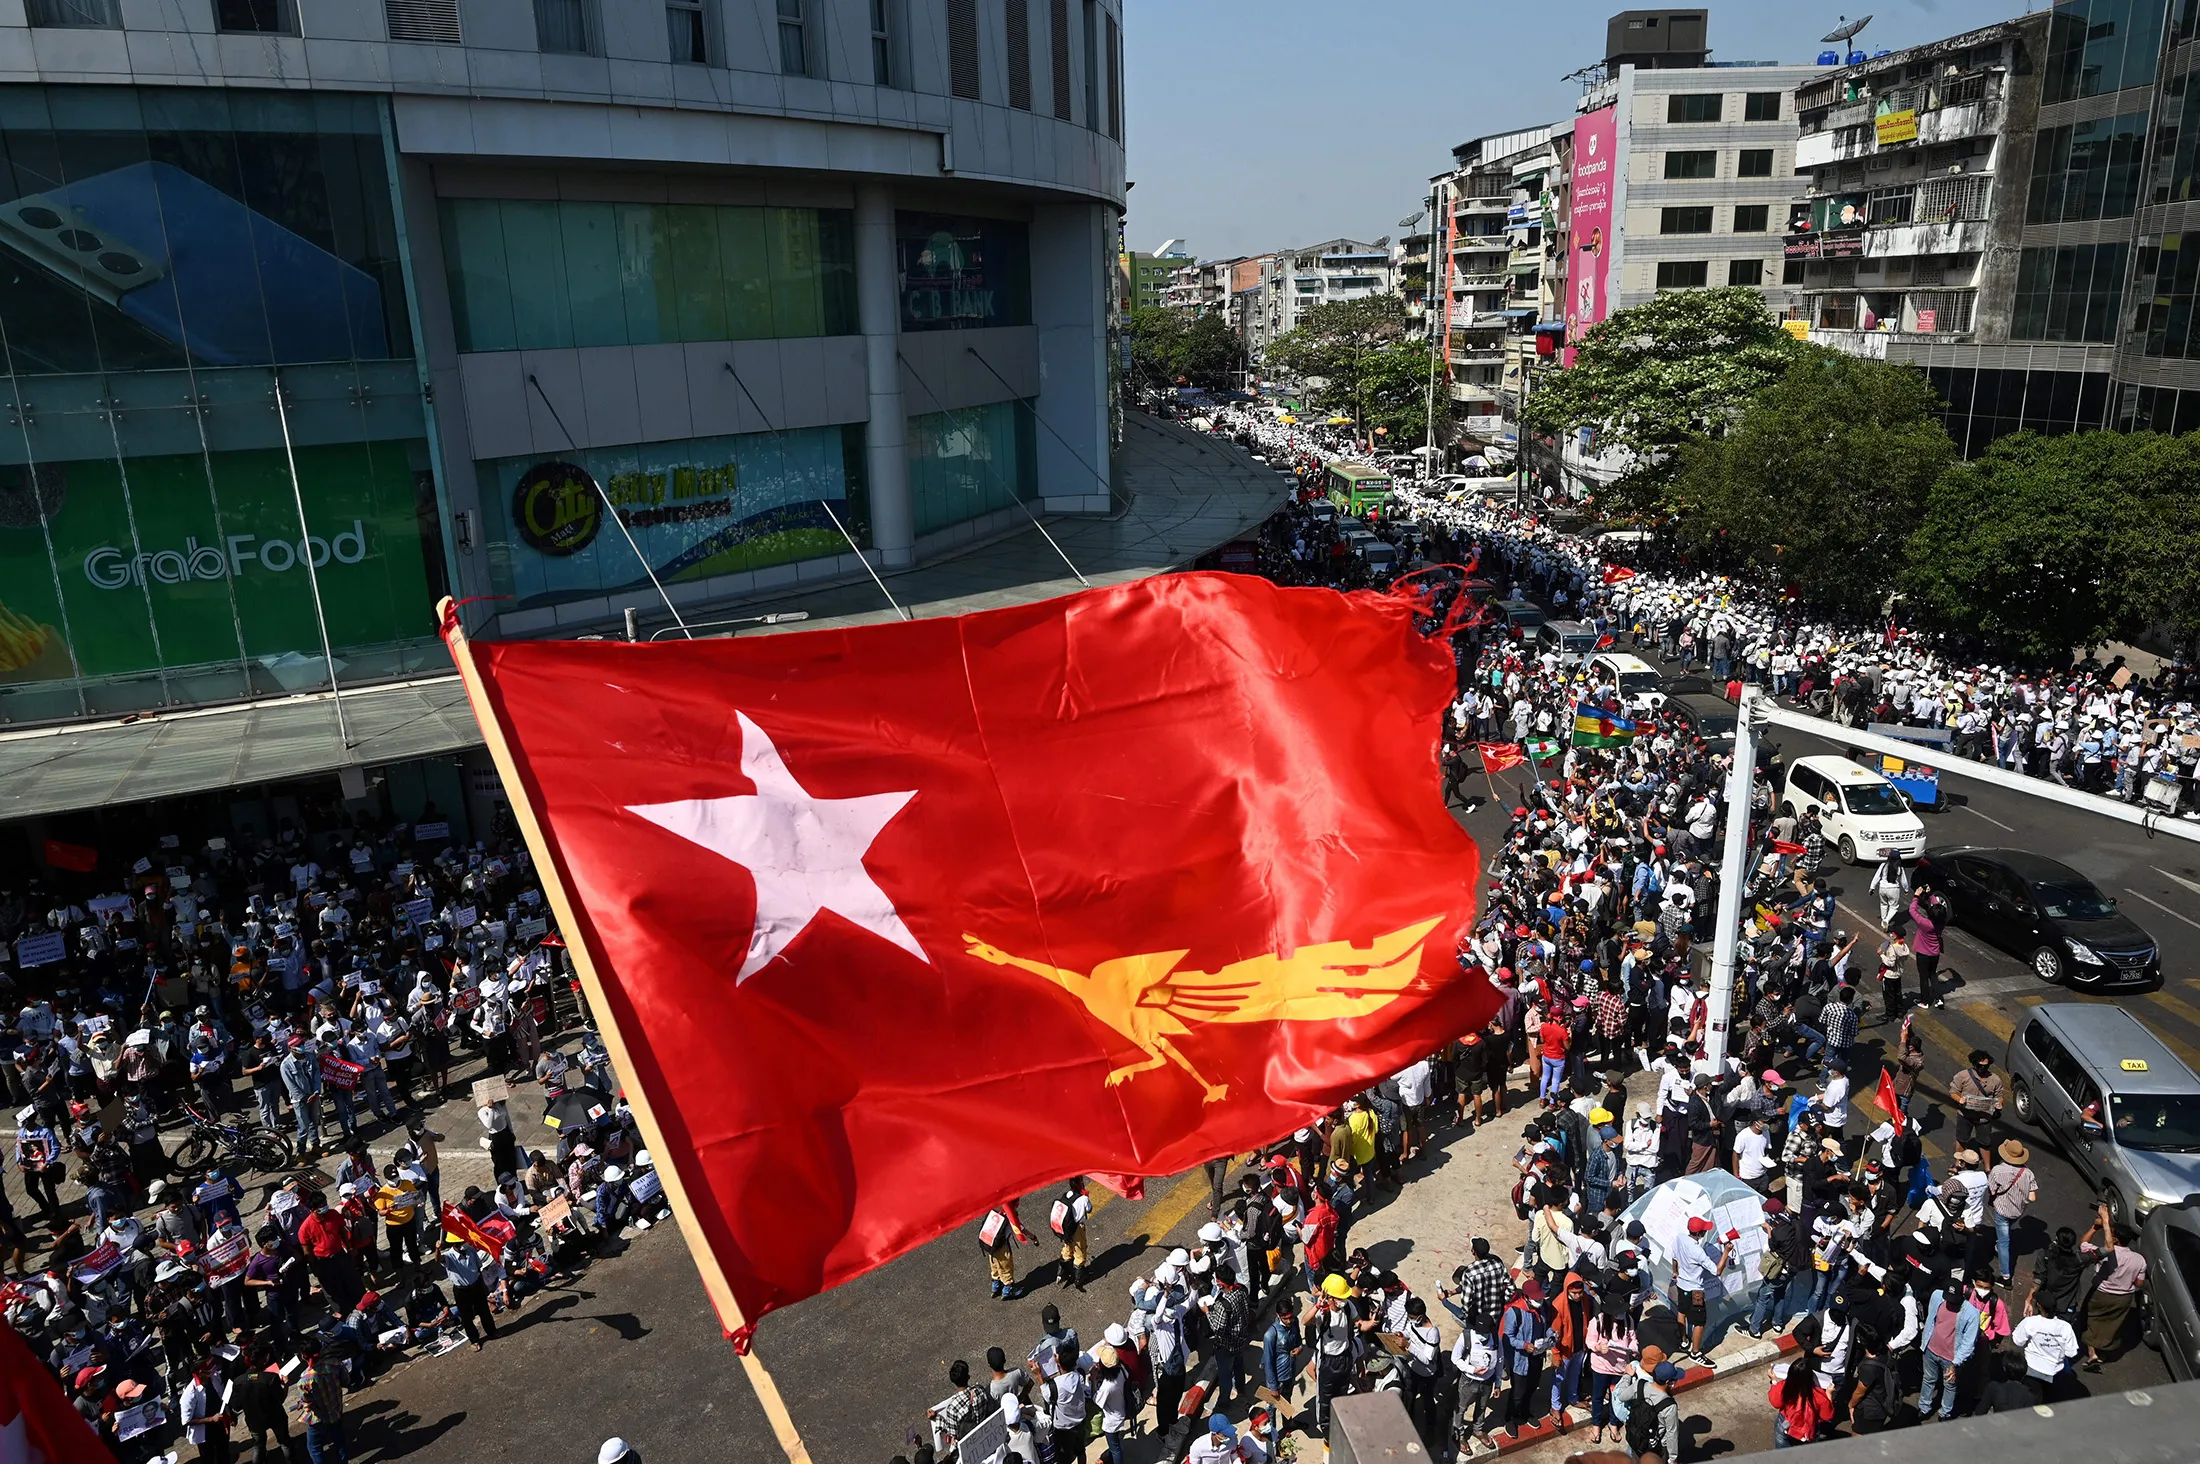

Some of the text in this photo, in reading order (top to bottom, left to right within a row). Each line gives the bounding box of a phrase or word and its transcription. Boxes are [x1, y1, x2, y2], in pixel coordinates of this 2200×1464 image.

[1577, 157, 1607, 178] foodpanda
[951, 289, 996, 317] BANK
[607, 463, 736, 506] City Mart
[549, 523, 575, 546] Mart
[84, 519, 367, 590] GrabFood
[325, 1058, 340, 1068] STOP
[118, 1423, 139, 1435] FREE
